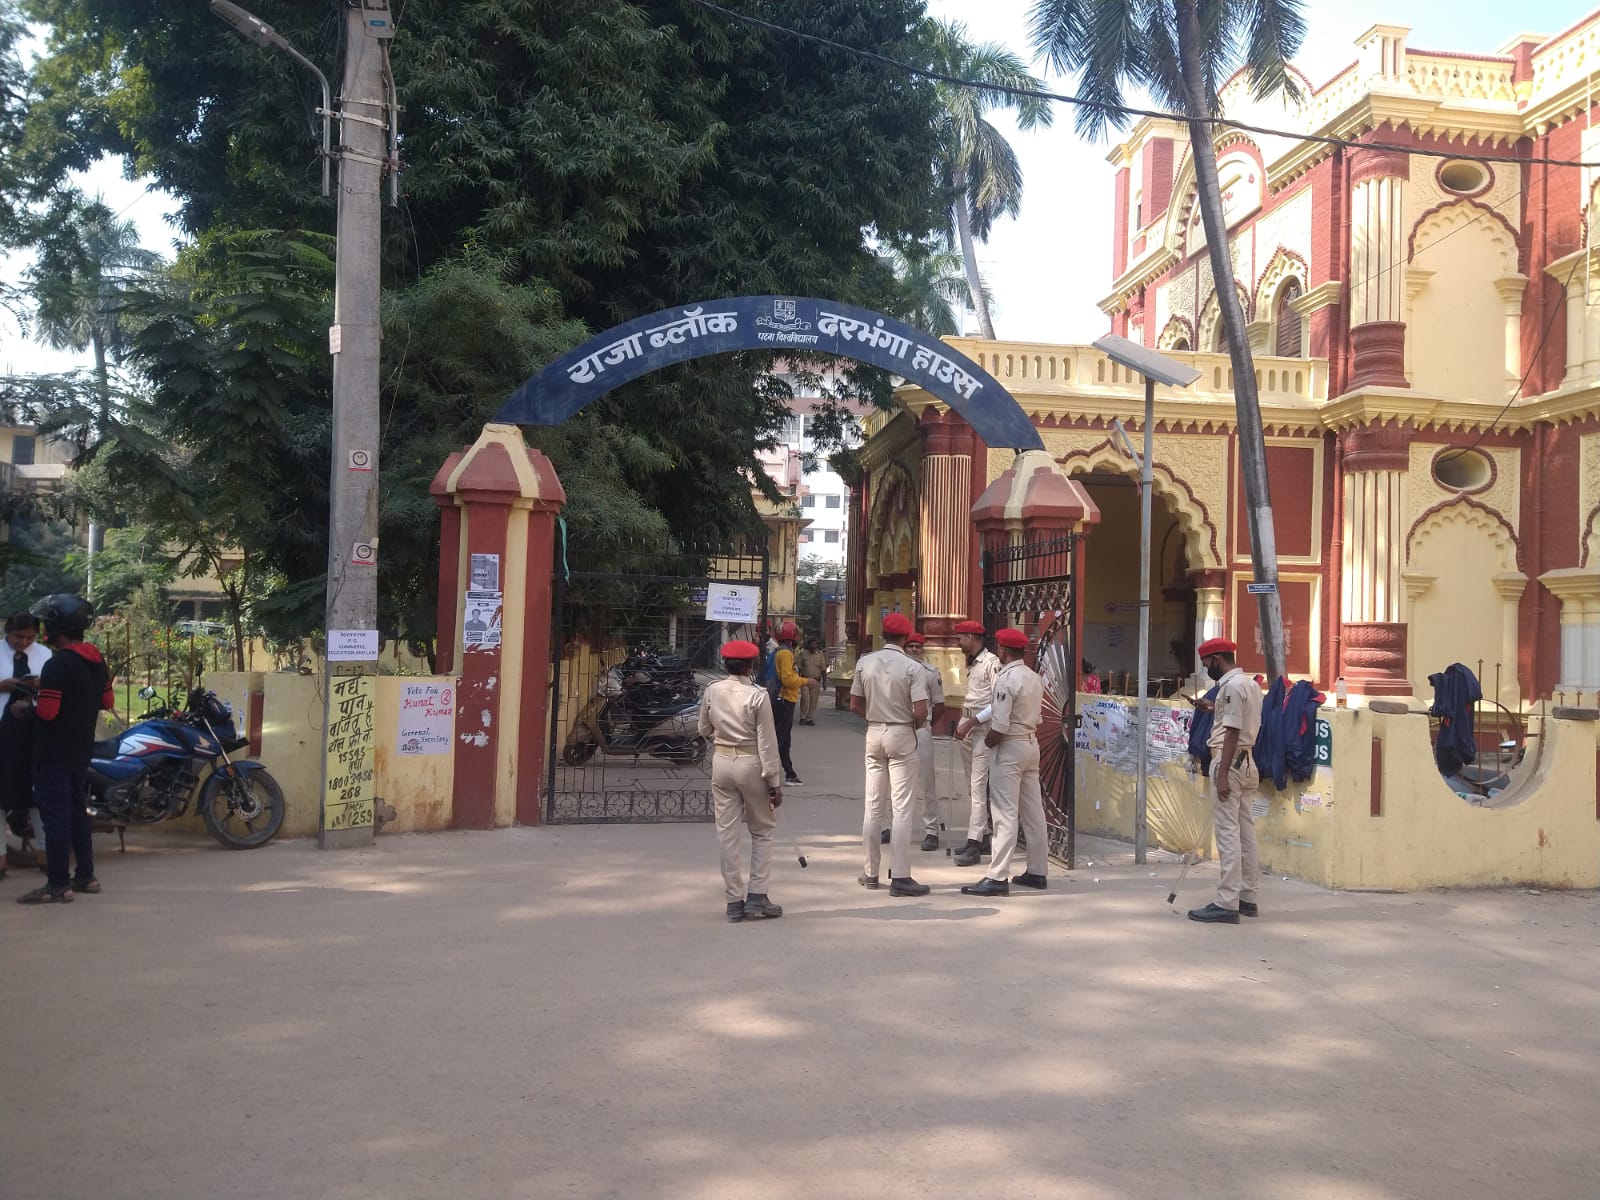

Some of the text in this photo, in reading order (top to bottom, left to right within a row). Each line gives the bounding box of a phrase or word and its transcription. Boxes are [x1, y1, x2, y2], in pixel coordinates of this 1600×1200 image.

[567, 306, 738, 384] राजा ब्लॉक
[757, 332, 775, 342] पटना
[817, 312, 984, 400] दरभंगा हाउस
[338, 694, 368, 715] पान
[338, 746, 366, 764] 15545
[340, 786, 361, 800] 268
